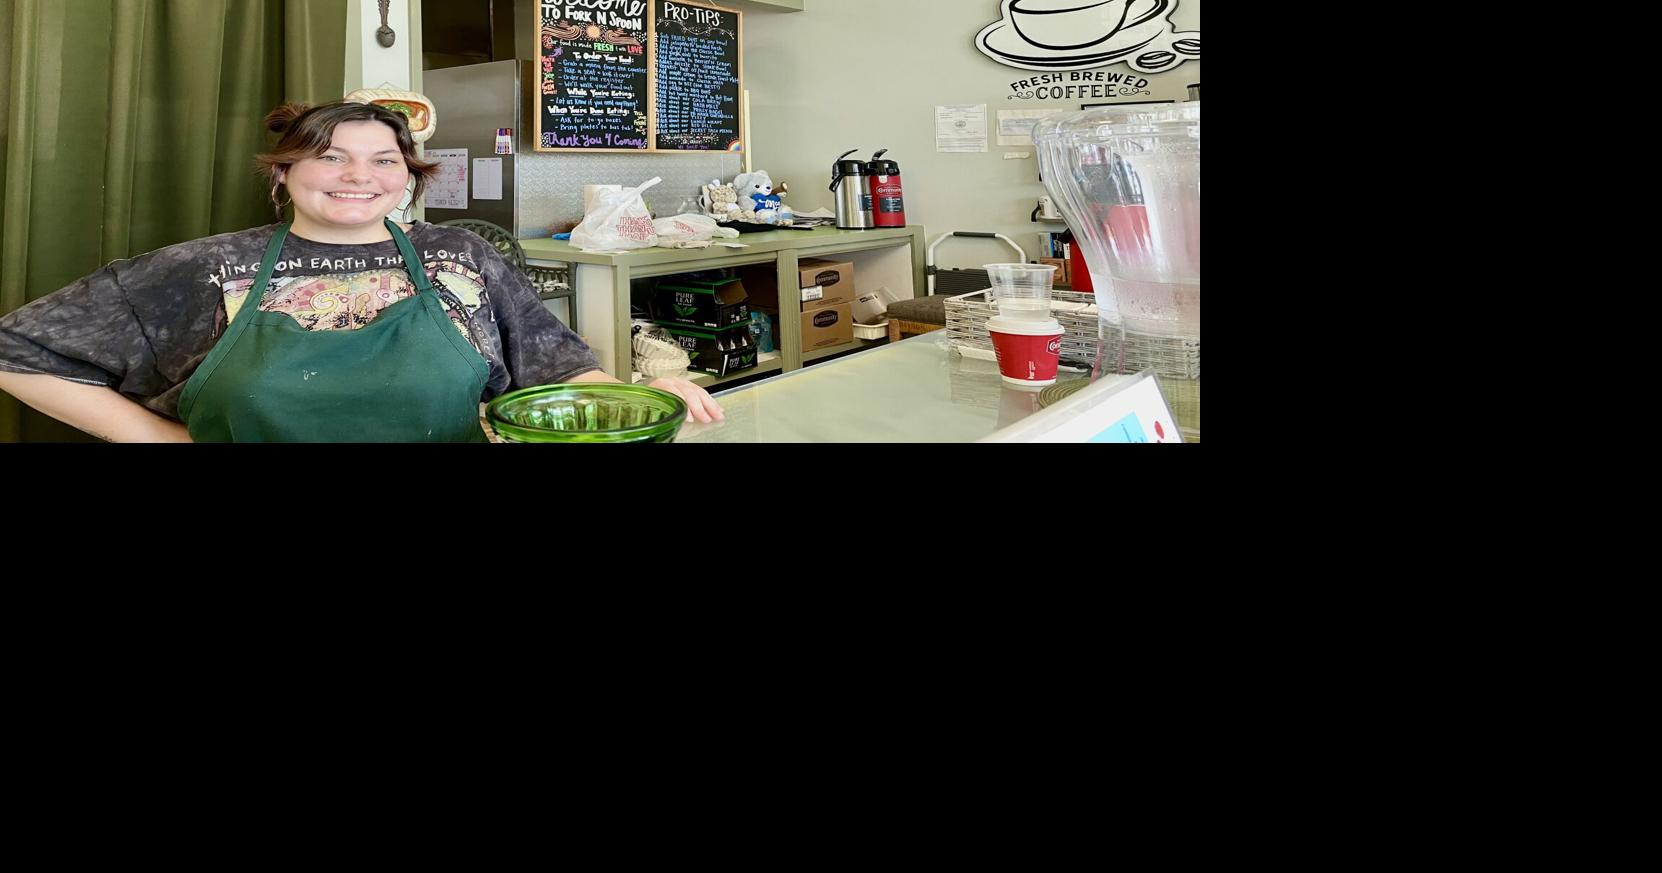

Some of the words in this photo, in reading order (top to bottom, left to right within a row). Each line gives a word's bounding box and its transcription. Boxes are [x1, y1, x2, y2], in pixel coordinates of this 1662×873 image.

[565, 6, 592, 22] FORK
[597, 11, 606, 25] N
[609, 12, 642, 30] SPOON
[594, 43, 614, 52] FRESH
[627, 46, 643, 54] LOVE
[1010, 73, 1063, 91] FRESH
[1070, 72, 1149, 89] BREWED
[567, 88, 587, 96] While
[611, 91, 635, 99] Eating:
[1036, 85, 1117, 99] COFFEE
[547, 105, 567, 113] When
[569, 106, 587, 114] You're
[560, 124, 577, 133] Bring
[580, 124, 598, 132] plates
[543, 132, 581, 146] Thank
[580, 134, 602, 147] You
[604, 133, 611, 146] 4
[275, 258, 302, 271] ON
[311, 256, 367, 271] EARTH
